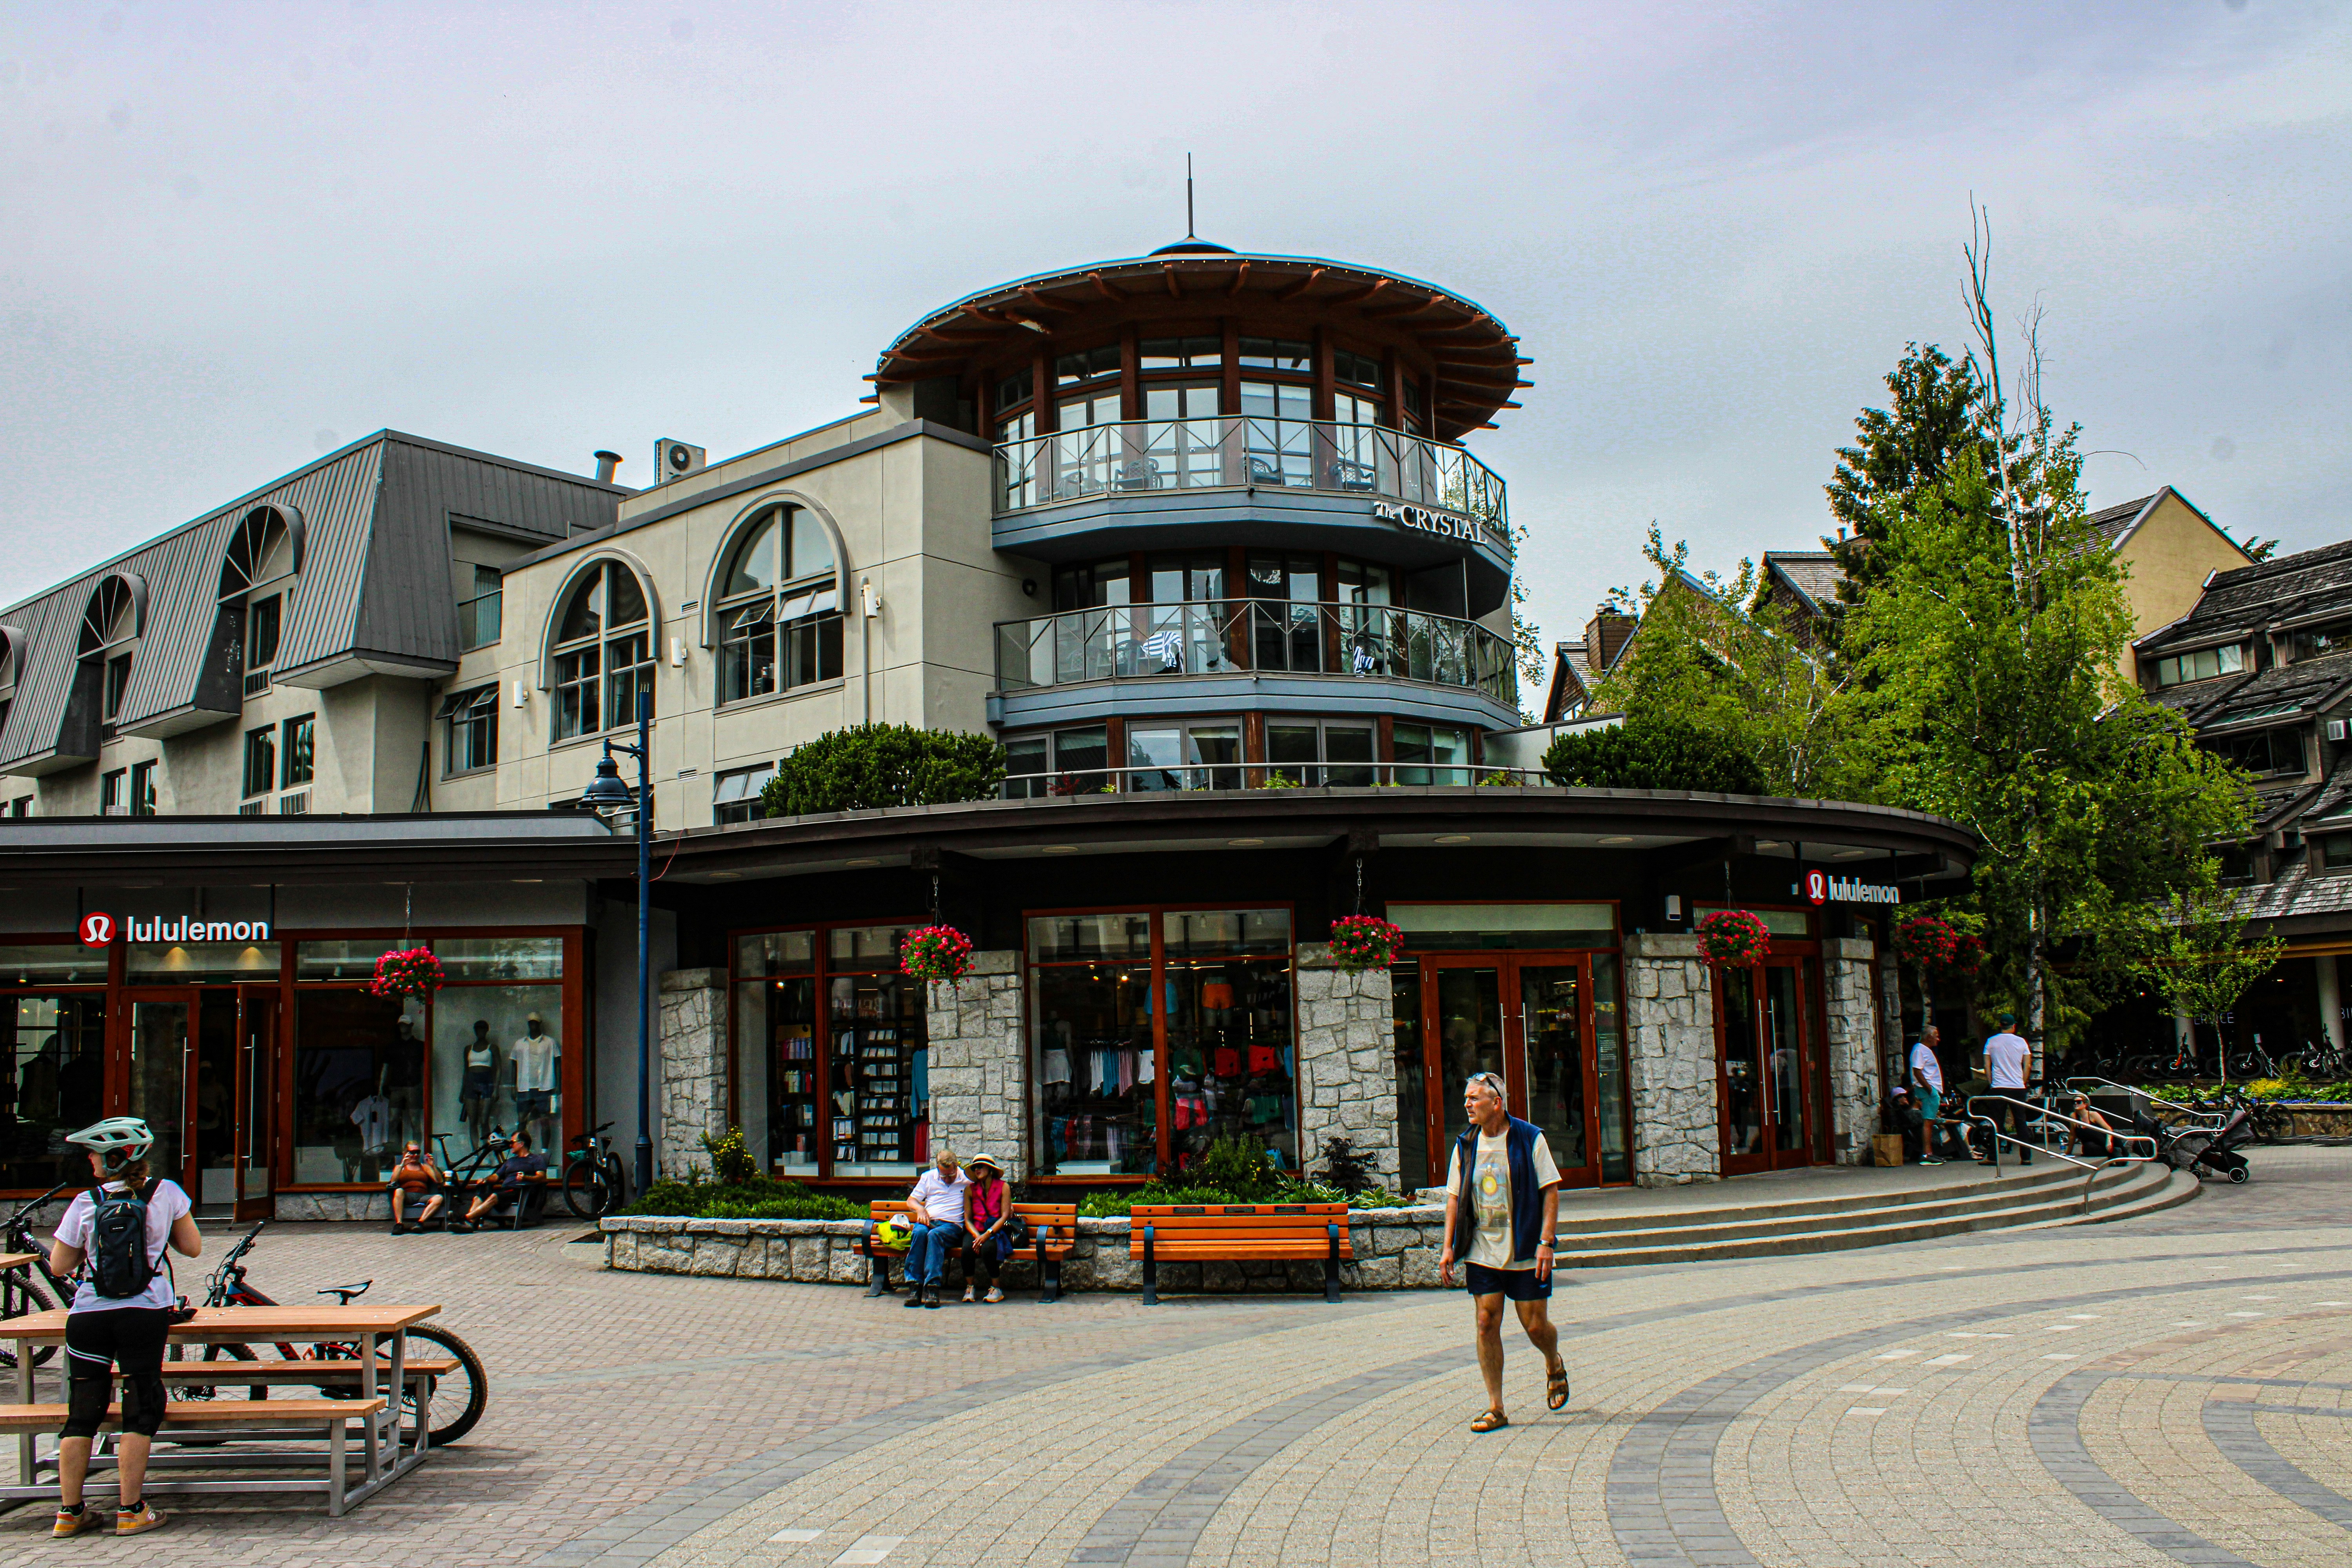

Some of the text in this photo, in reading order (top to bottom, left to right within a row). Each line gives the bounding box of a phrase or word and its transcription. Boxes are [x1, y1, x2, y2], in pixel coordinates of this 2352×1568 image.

[1374, 501, 1488, 545] The CRYSTAL
[1828, 875, 1900, 903] lululemon
[127, 916, 268, 942] lululemon
